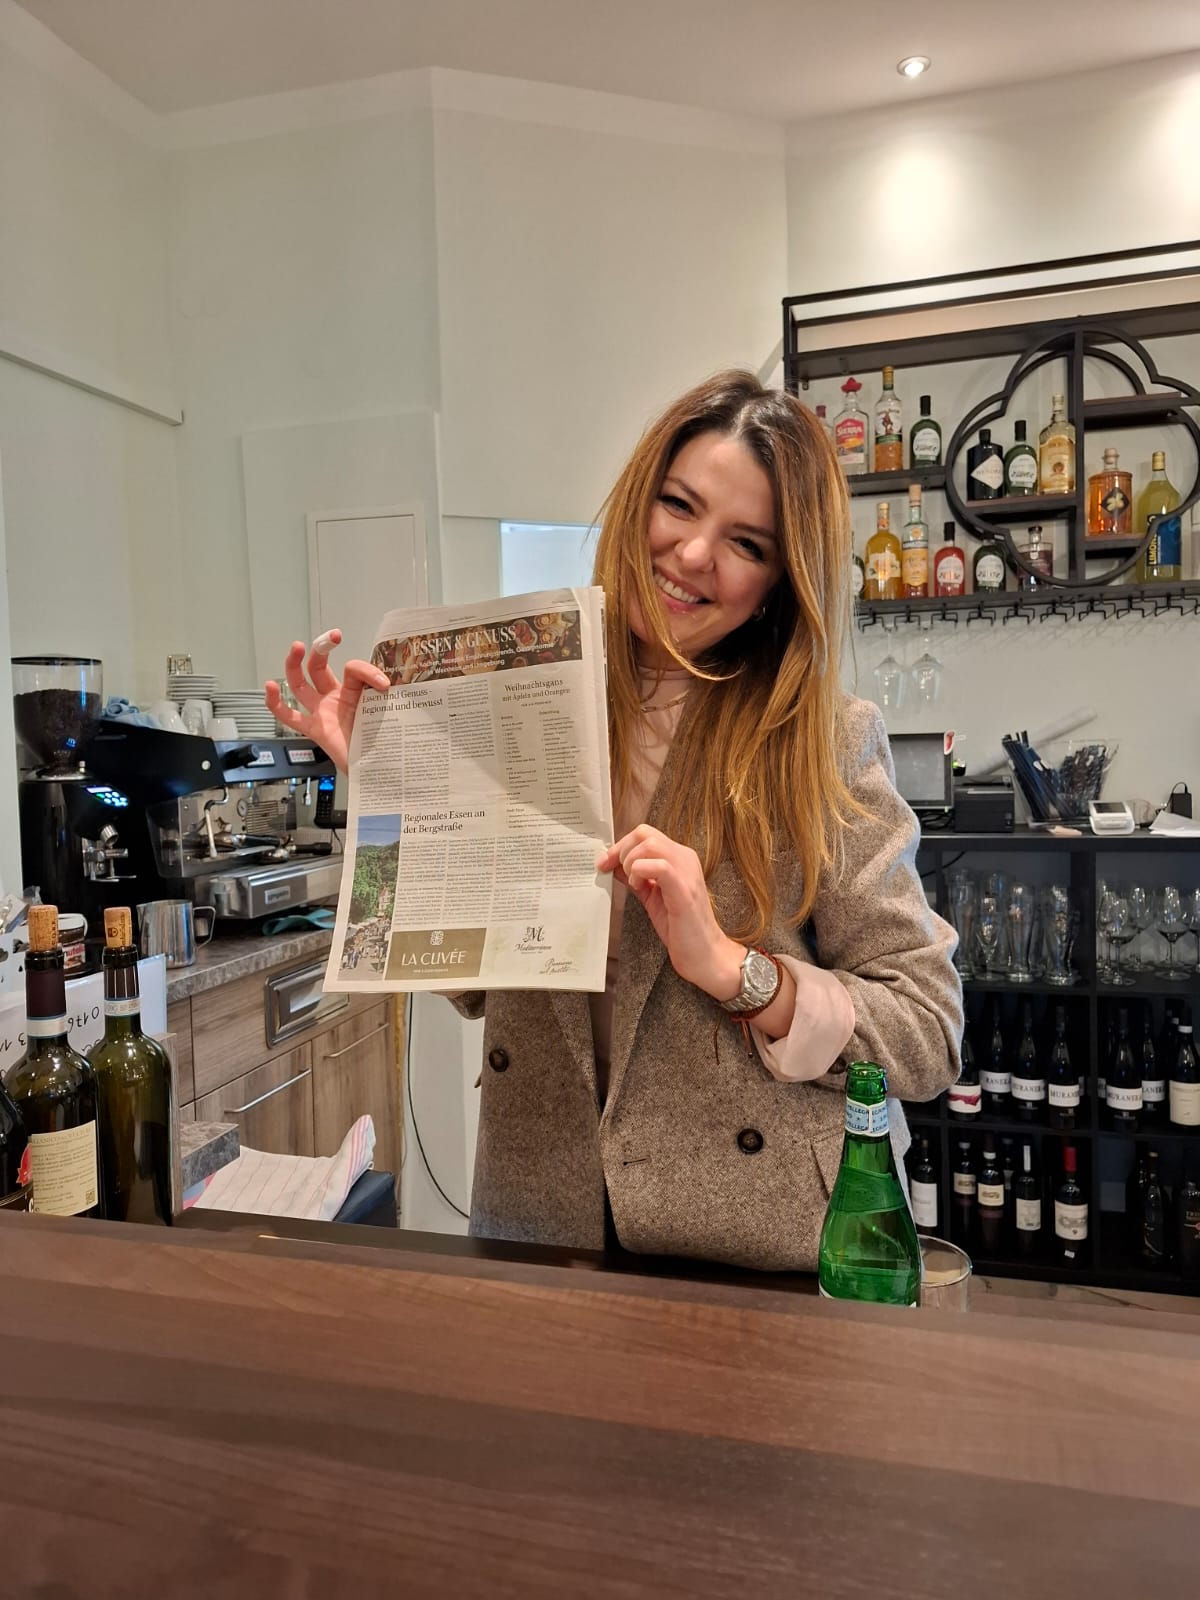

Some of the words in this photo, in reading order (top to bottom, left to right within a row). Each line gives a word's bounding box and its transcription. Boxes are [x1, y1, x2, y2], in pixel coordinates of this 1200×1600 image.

[412, 637, 452, 657] ESSEN
[454, 635, 464, 650] &
[466, 625, 517, 648] GENUSS
[504, 679, 564, 692] Weihnachtsgans
[383, 691, 399, 700] und
[401, 689, 428, 699] Genuss
[532, 691, 543, 699] und
[362, 703, 394, 715] Regional
[395, 701, 411, 711] und
[412, 699, 443, 710] bewusst
[404, 811, 448, 824] Regionales
[449, 810, 473, 819] Essen
[474, 810, 485, 818] an
[403, 825, 417, 834] der
[418, 822, 463, 835] Bergstraße
[401, 953, 417, 966] LA
[420, 948, 467, 965] CUVÉE
